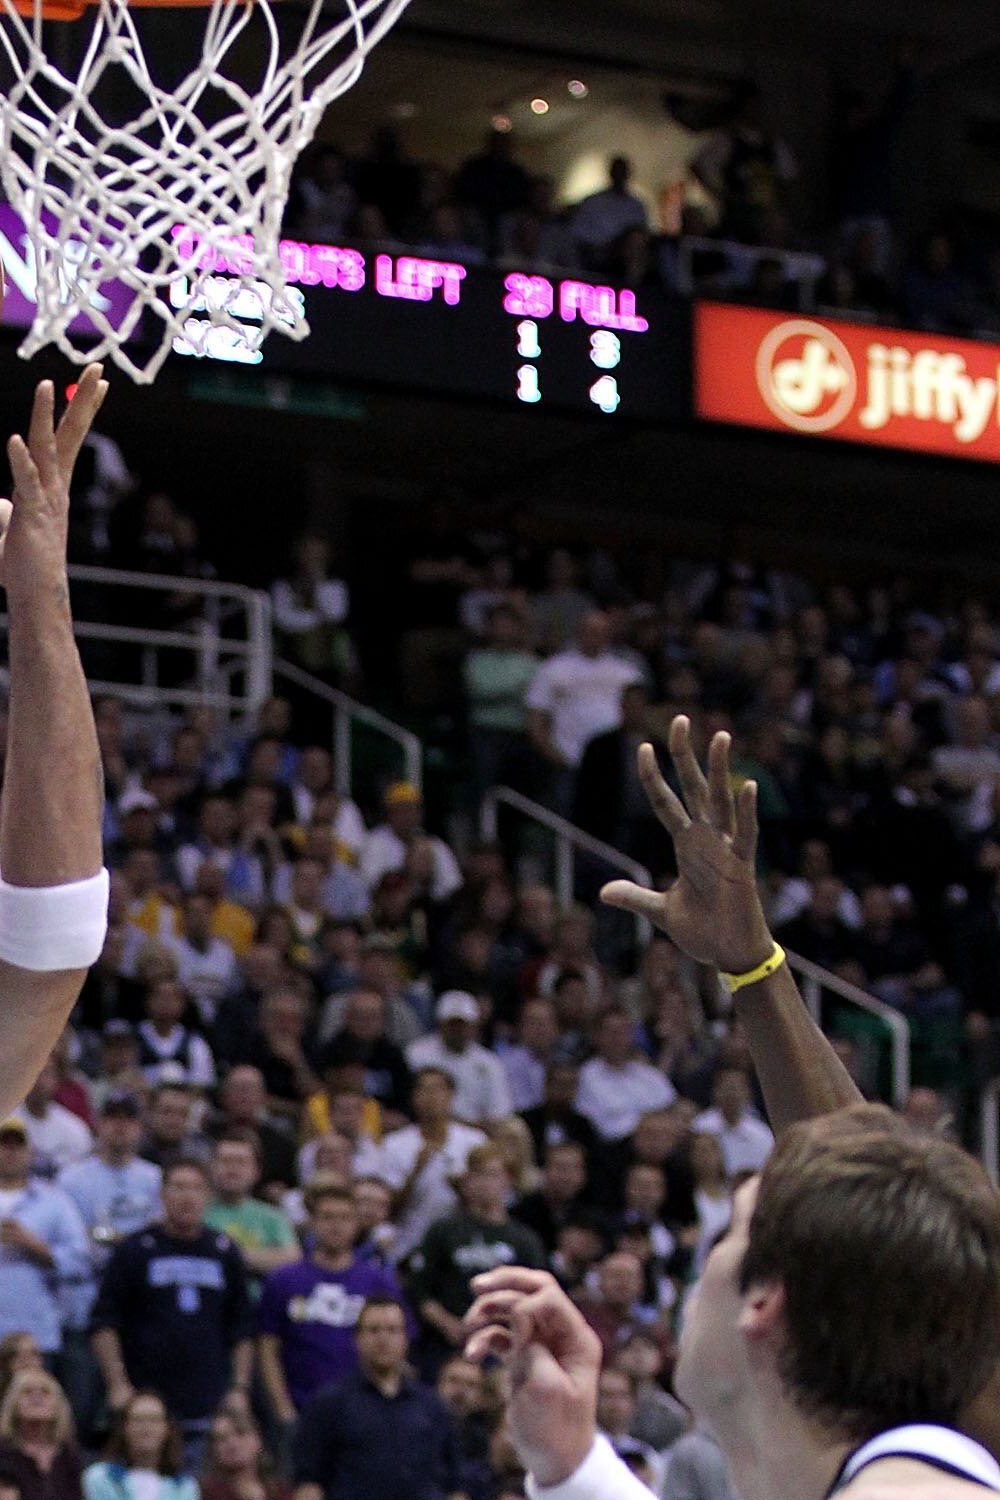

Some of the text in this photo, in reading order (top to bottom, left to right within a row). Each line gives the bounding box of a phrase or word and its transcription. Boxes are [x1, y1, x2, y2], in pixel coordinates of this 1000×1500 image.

[376, 254, 467, 305] LEFT
[560, 279, 649, 332] FULL
[517, 319, 541, 358] 1
[517, 364, 621, 413] 1 4
[858, 342, 996, 443] jiffy
